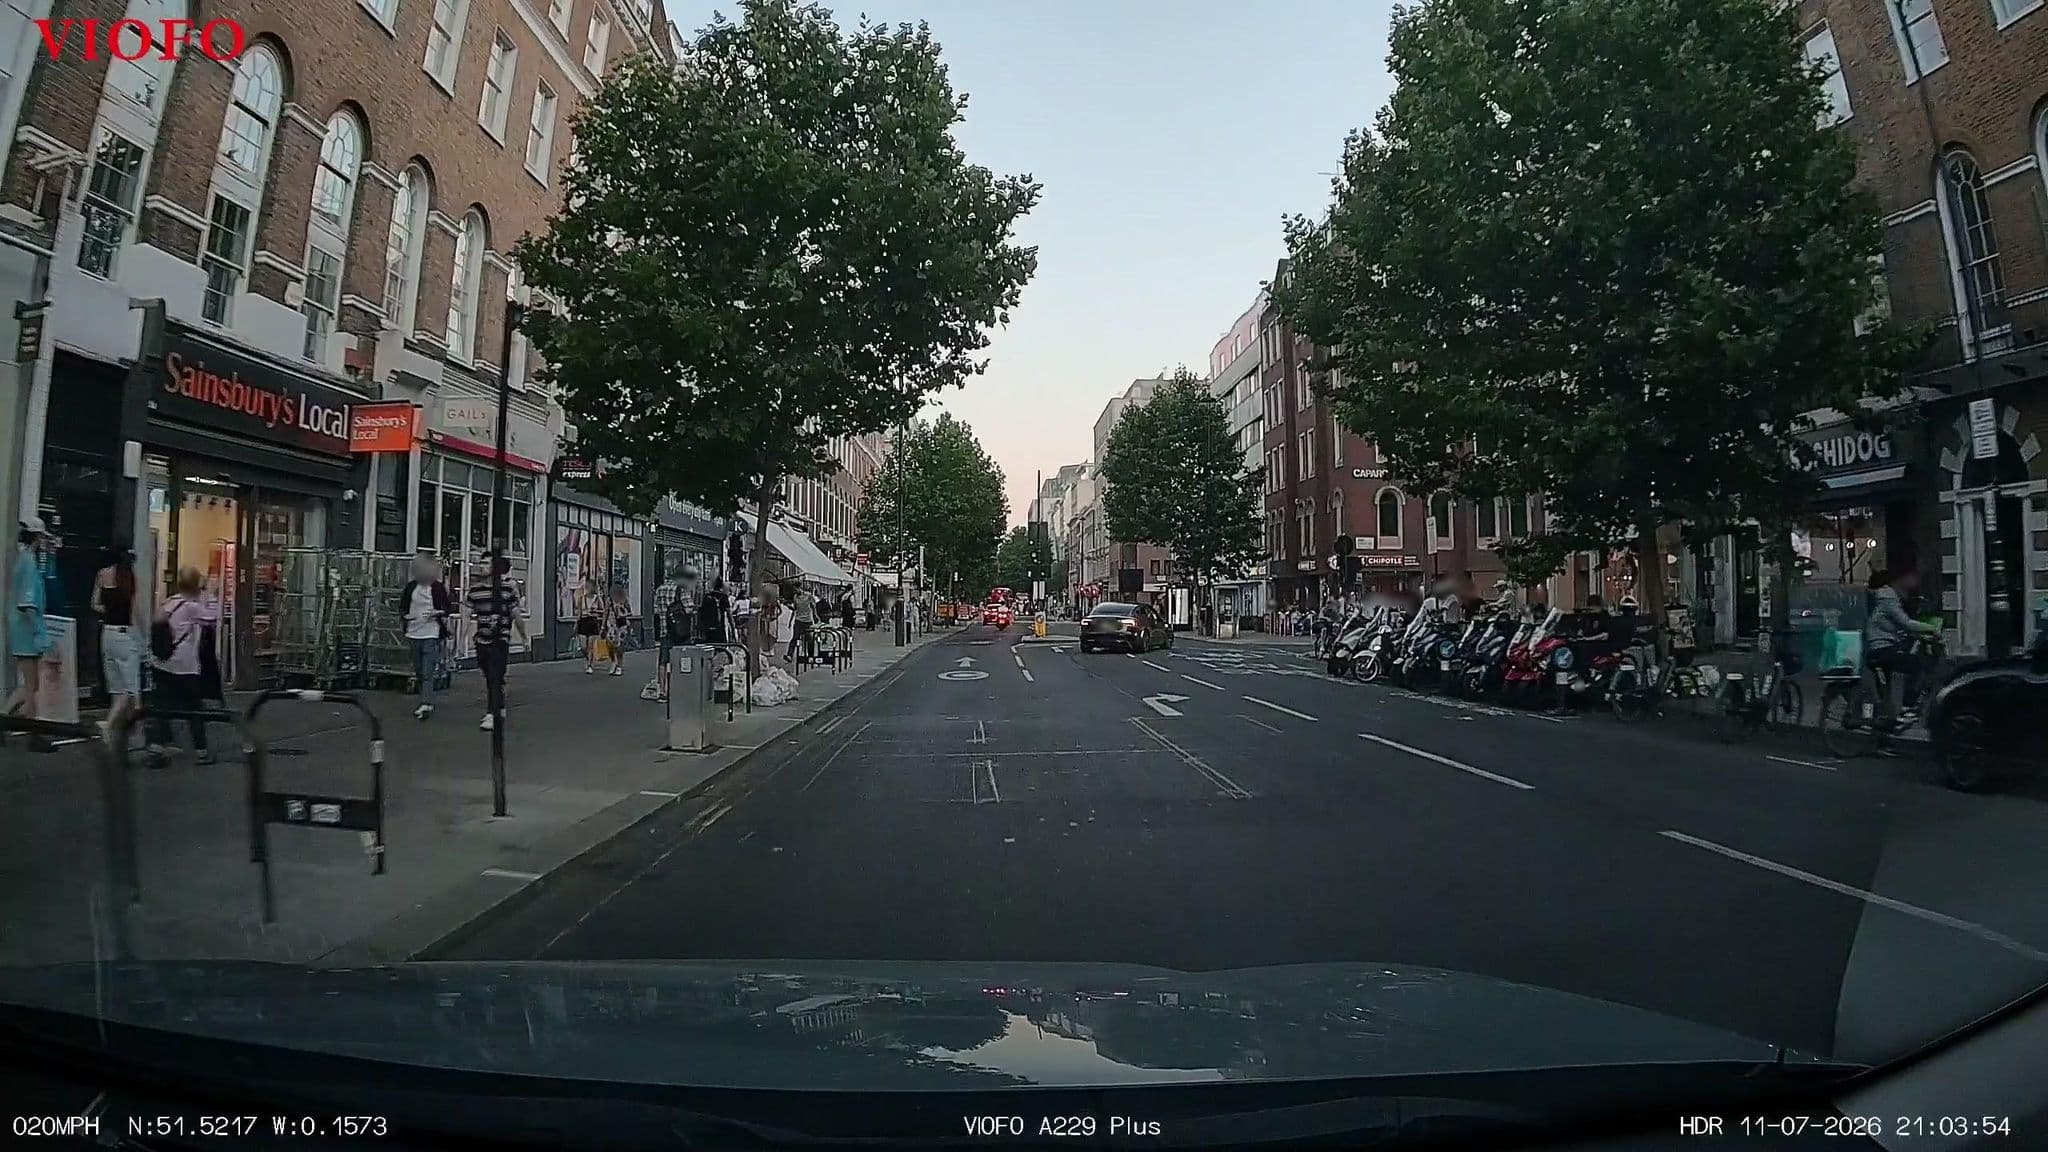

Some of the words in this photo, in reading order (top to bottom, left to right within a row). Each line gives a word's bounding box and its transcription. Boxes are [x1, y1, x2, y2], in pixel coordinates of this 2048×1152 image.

[164, 352, 294, 428] Sainsbury's
[298, 393, 349, 440] Local
[353, 415, 408, 432] Sainsbury's
[353, 428, 379, 441] Local
[562, 471, 591, 480] express
[1368, 557, 1402, 565] CHIPOTLE
